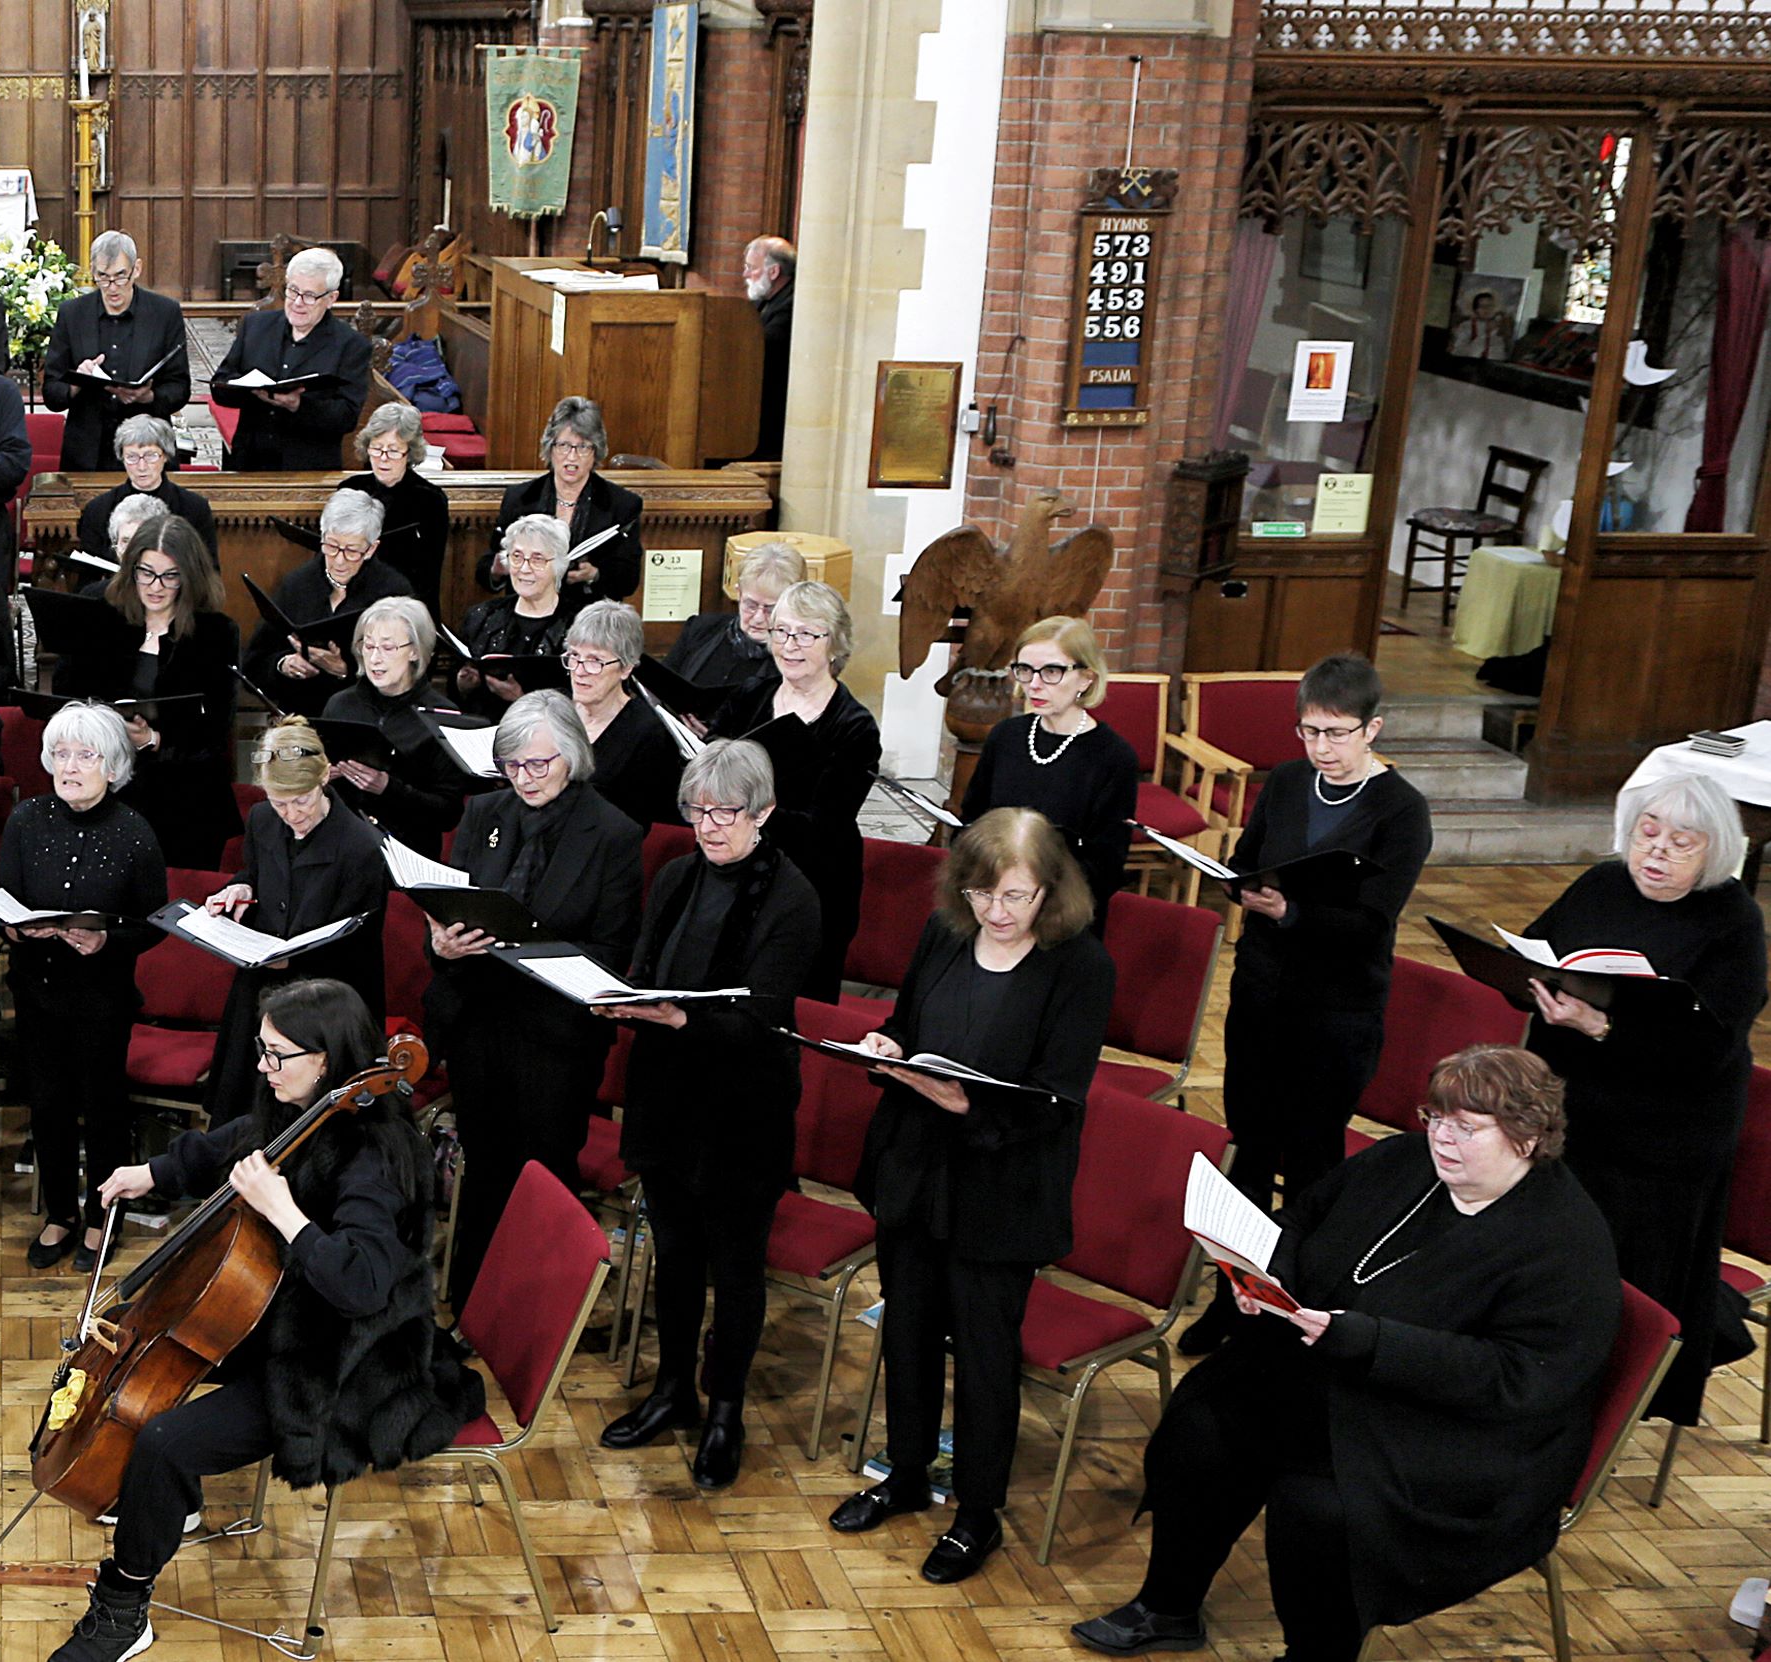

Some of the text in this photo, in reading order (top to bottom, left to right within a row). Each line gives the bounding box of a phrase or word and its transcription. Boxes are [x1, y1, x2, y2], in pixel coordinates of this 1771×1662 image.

[1100, 218, 1149, 231] HYMNS
[1093, 234, 1150, 256] 573
[1090, 261, 1146, 284] 491
[1087, 288, 1145, 311] 453
[1084, 315, 1141, 338] 556
[1089, 369, 1132, 382] PSALM
